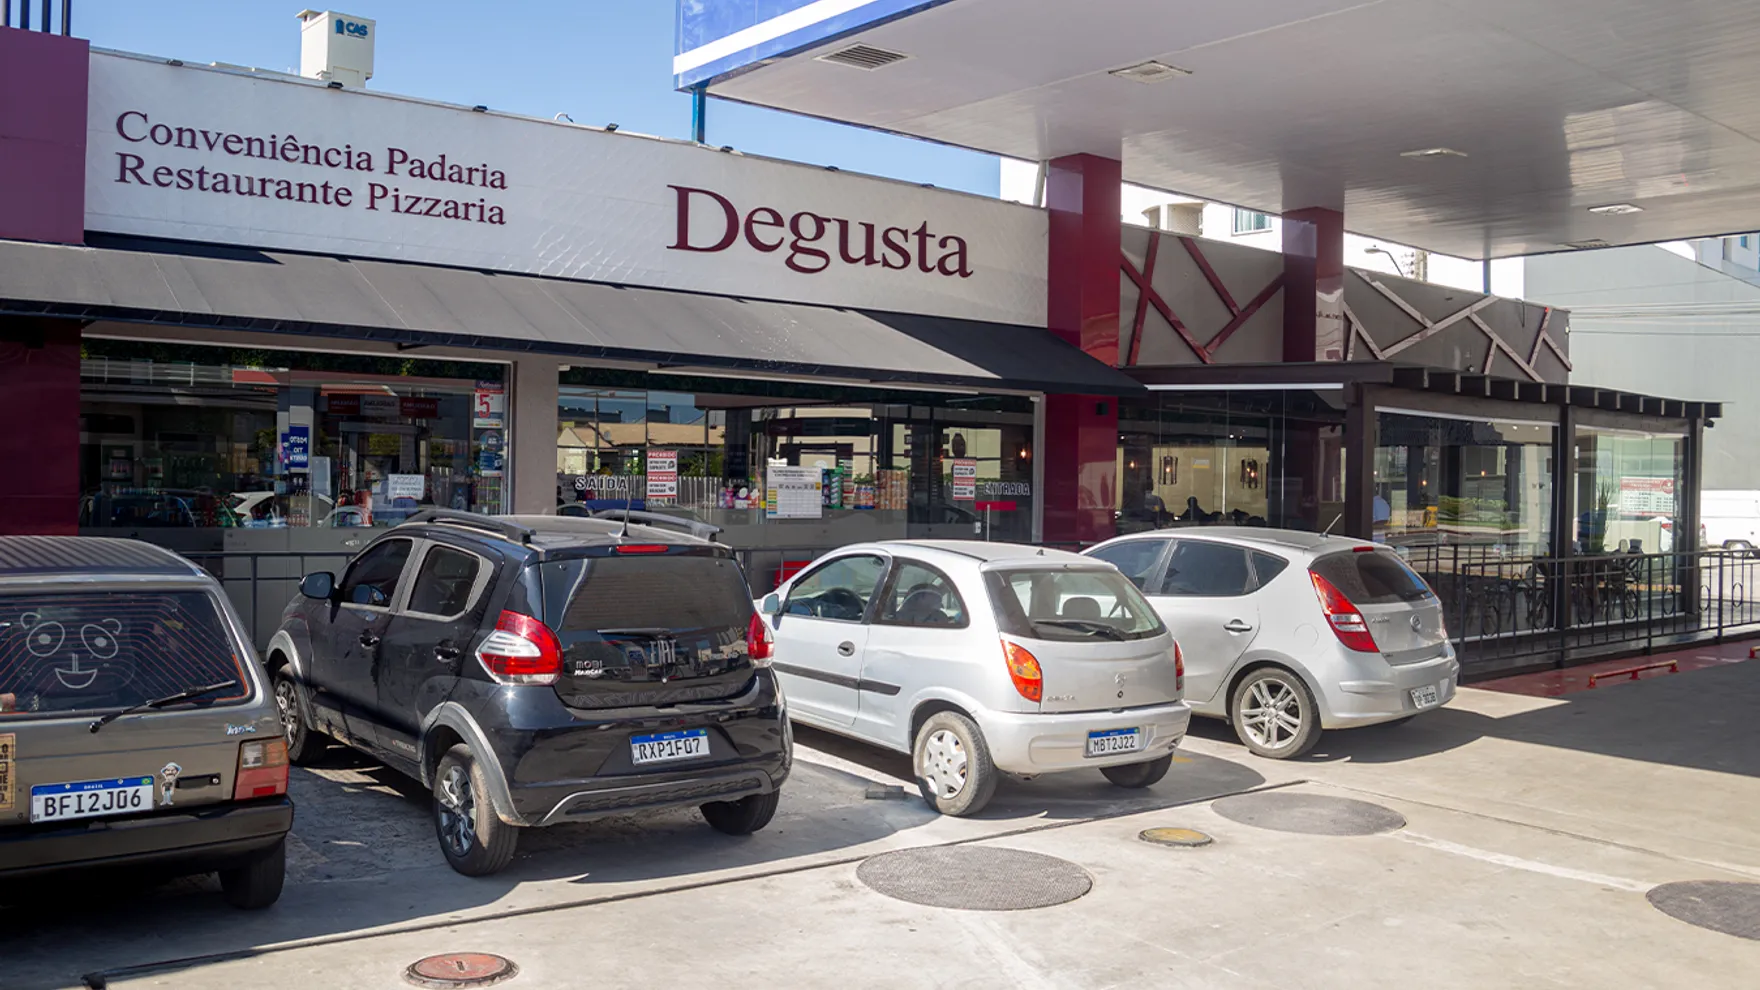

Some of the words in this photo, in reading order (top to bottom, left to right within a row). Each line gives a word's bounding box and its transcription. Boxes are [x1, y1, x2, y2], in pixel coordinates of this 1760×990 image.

[115, 110, 375, 172] Conveniência
[384, 147, 508, 190] Padaria
[114, 152, 353, 207] Restaurante
[365, 182, 507, 225] Pizzaria
[666, 184, 974, 278] Degusta
[983, 481, 1031, 496] ENTRADA
[649, 639, 677, 664] FIAT
[638, 738, 701, 760] RXP1F07
[1093, 736, 1136, 753] MBT2J22
[44, 788, 142, 817] BFI2J06
